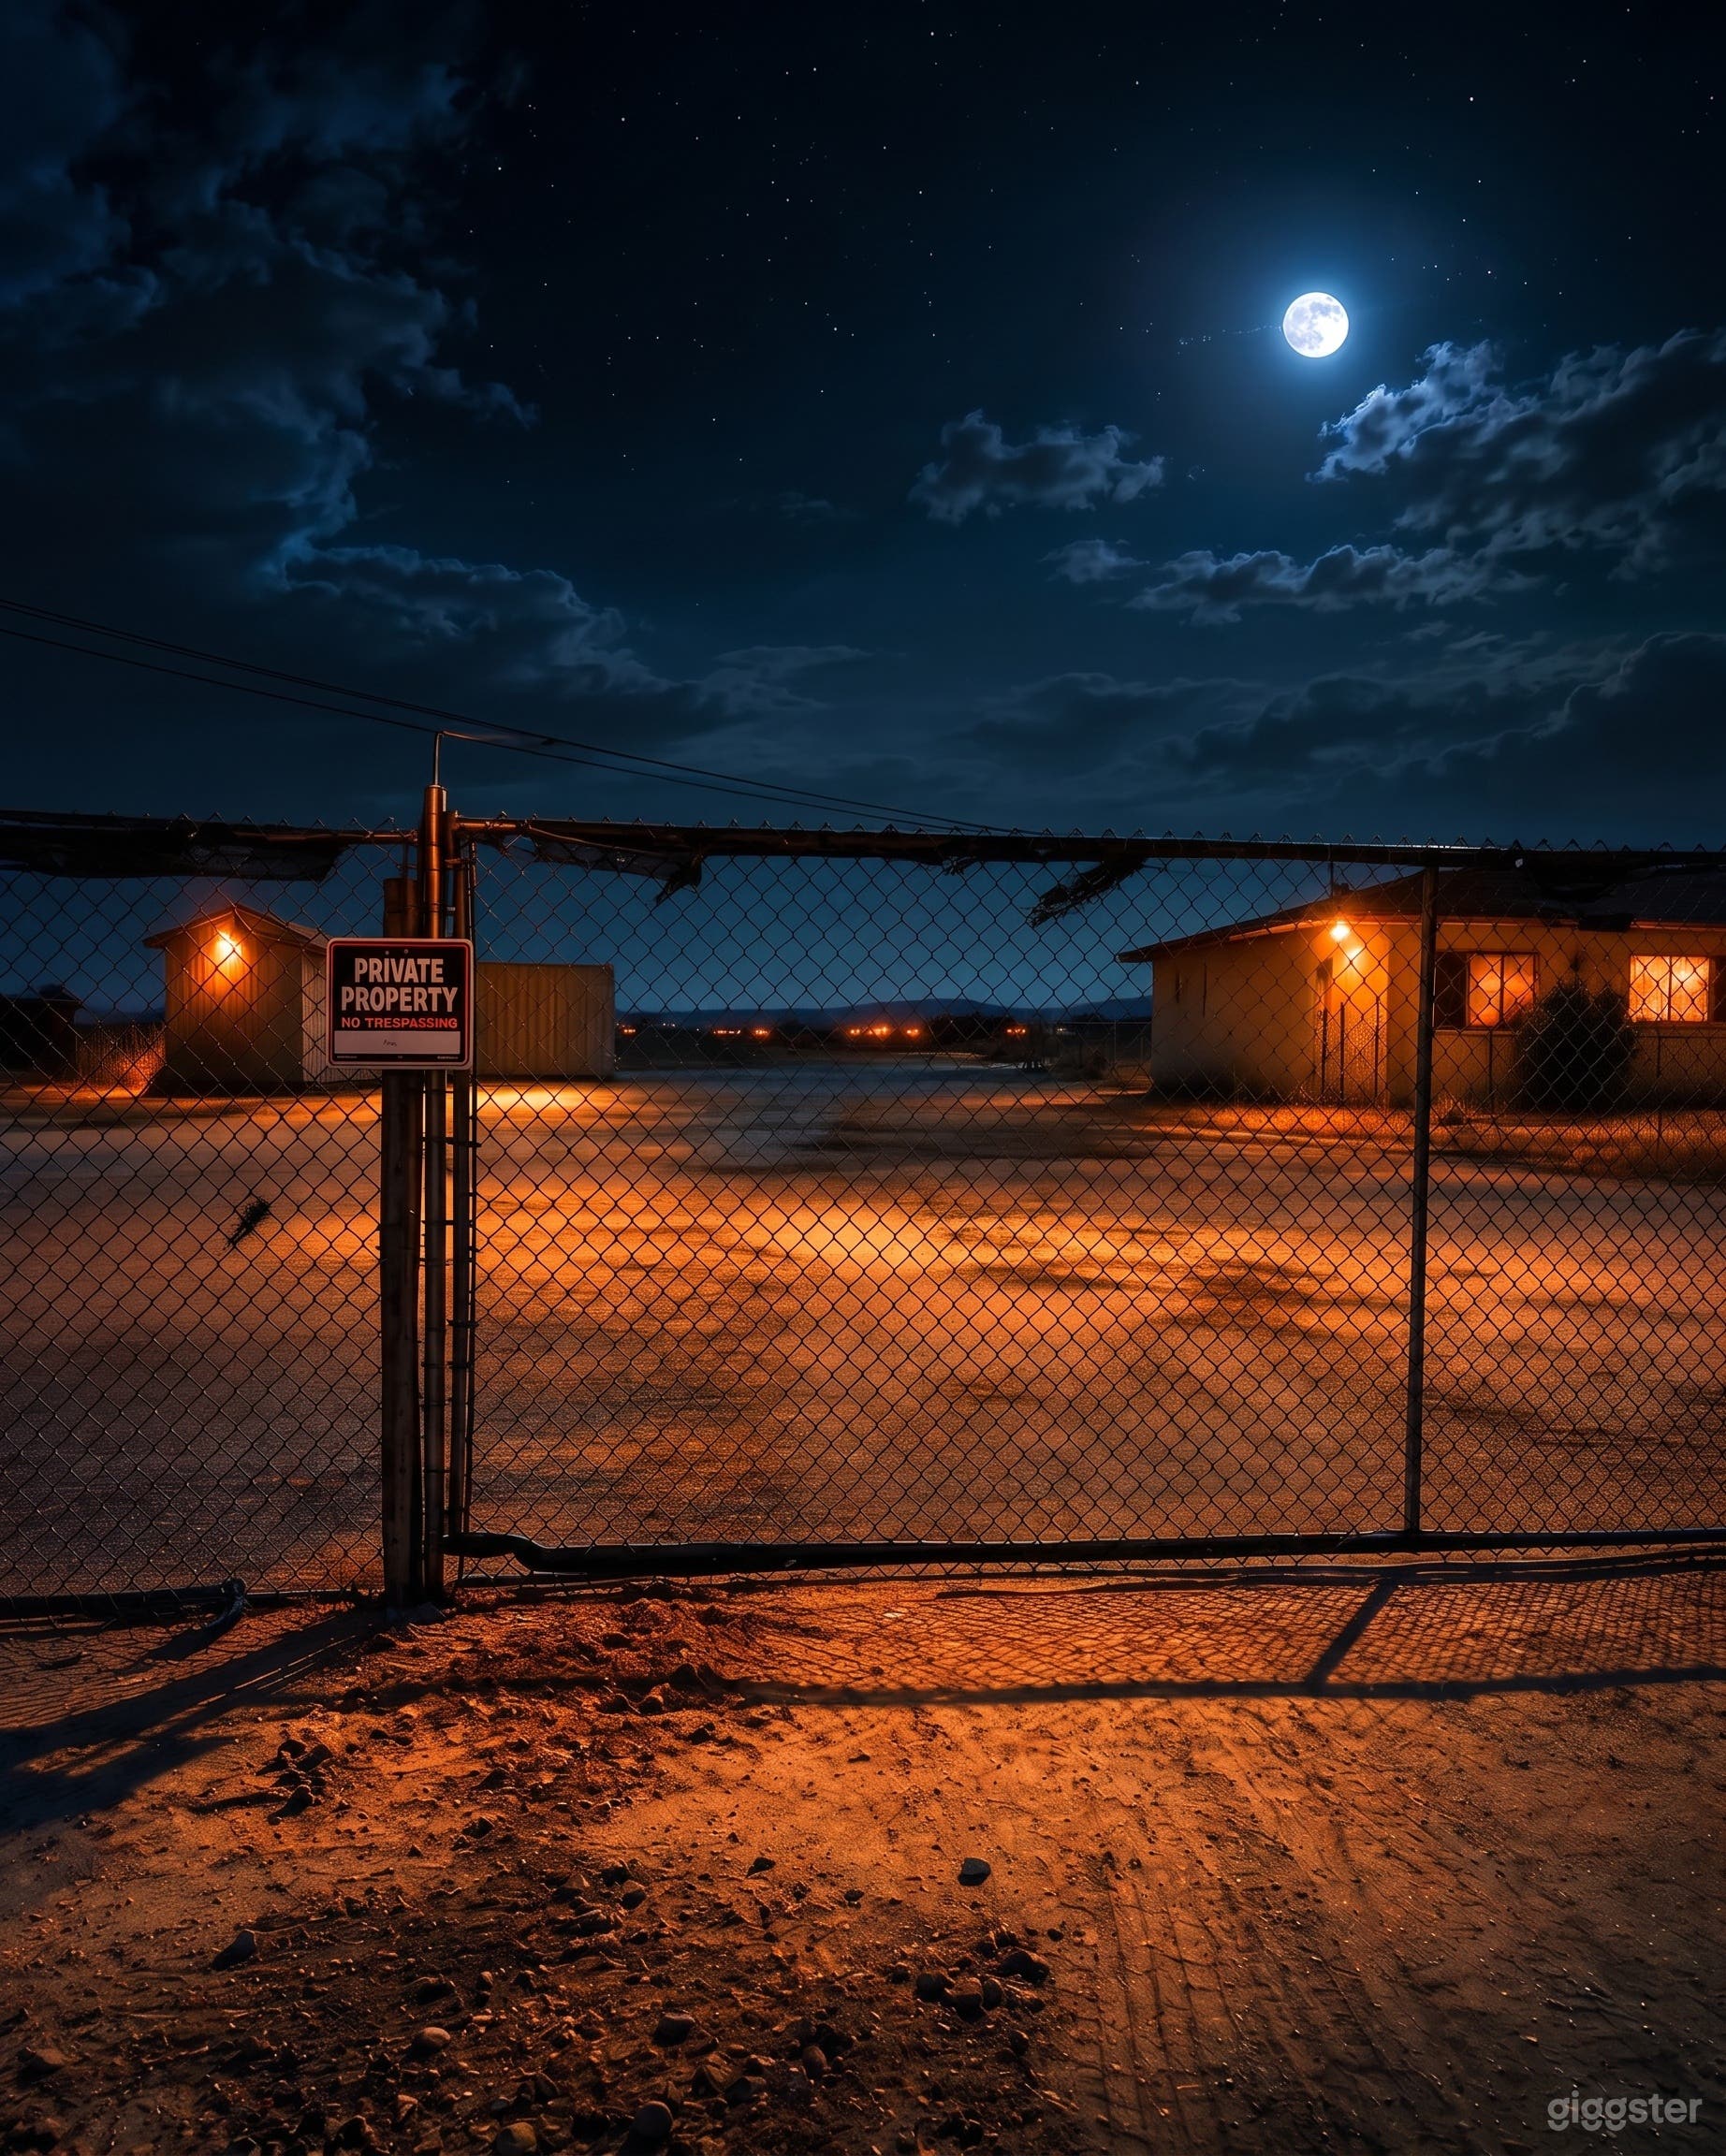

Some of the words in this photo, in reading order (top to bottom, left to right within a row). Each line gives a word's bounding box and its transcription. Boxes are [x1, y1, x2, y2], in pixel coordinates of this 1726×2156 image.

[355, 958, 444, 983] PRIVATE
[341, 986, 458, 1012] PROPERTY
[342, 1017, 360, 1027] NO
[365, 1018, 457, 1028] TRESPASSING
